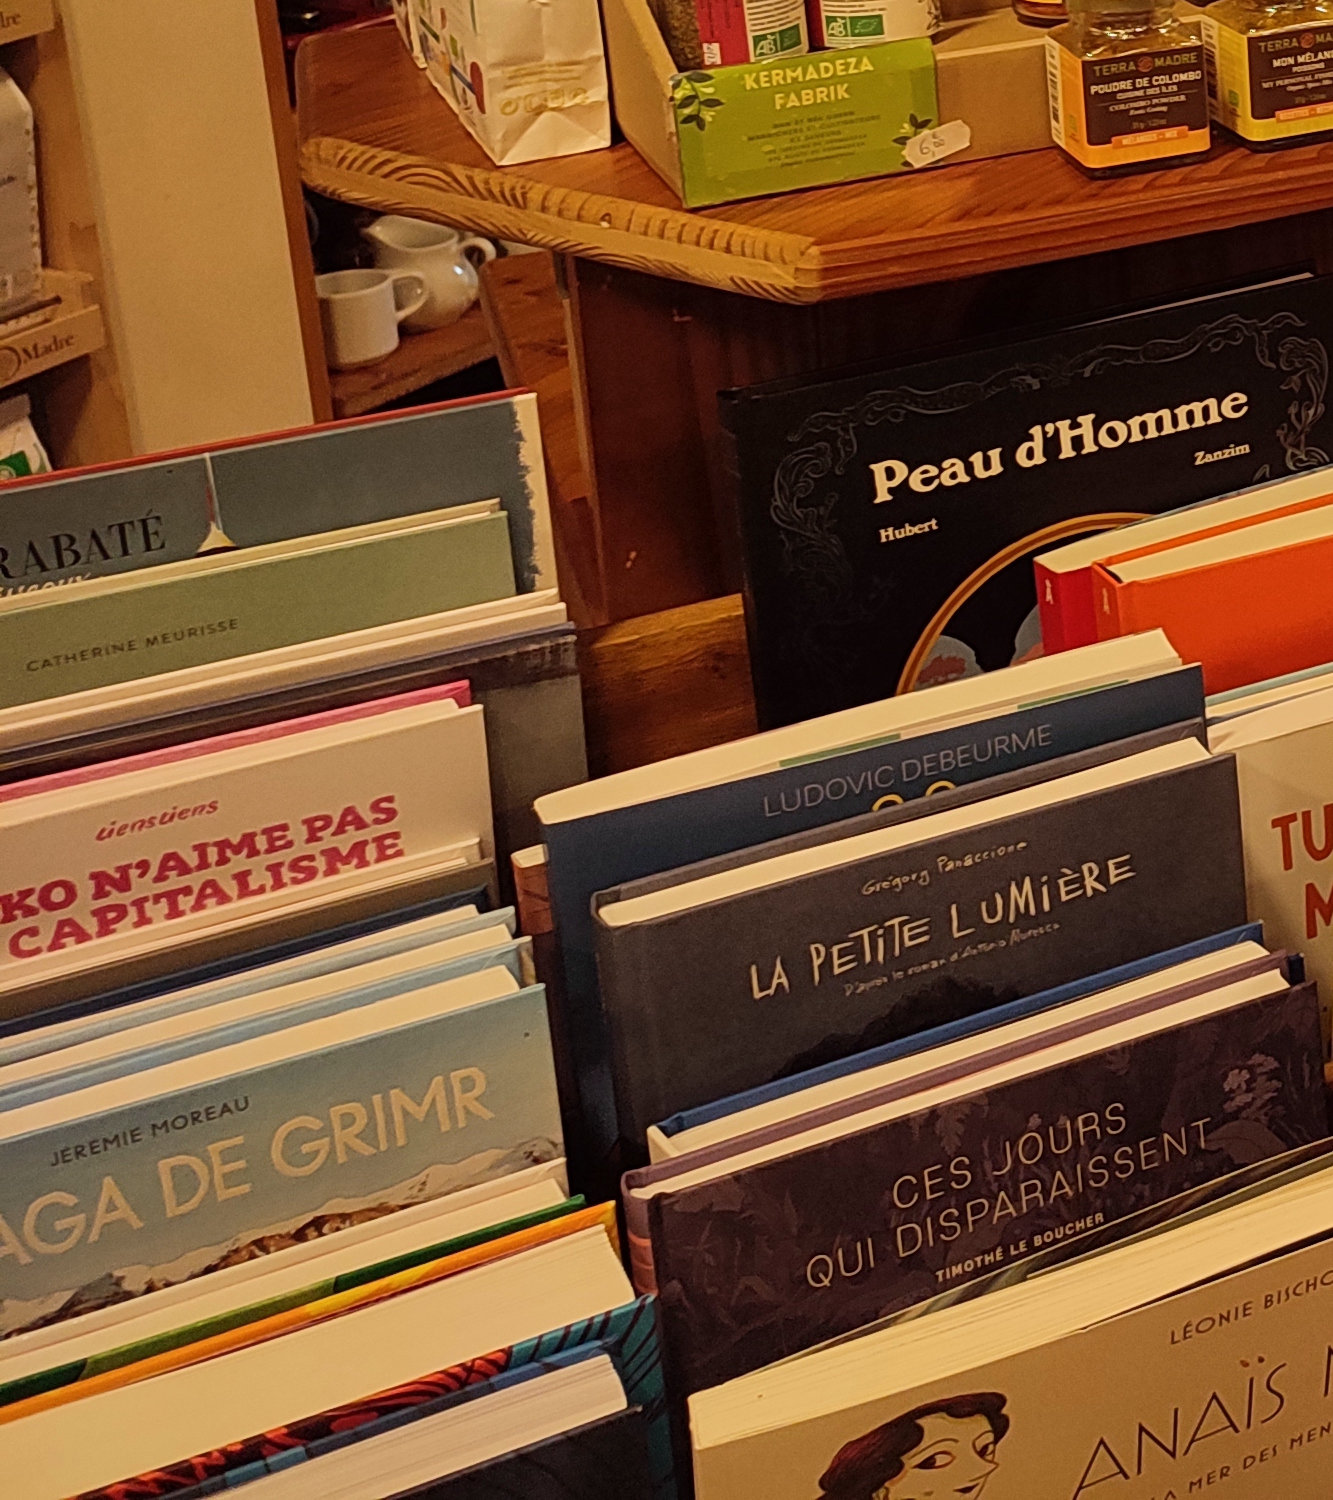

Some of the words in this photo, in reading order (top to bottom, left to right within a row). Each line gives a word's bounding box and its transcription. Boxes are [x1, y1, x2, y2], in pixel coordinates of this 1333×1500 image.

[1093, 64, 1136, 78] TERRA
[1154, 52, 1198, 67] MADRE
[1258, 40, 1299, 54] TERRA
[1272, 56, 1295, 69] MON
[744, 55, 874, 90] KERMADEZA
[775, 82, 850, 110] FABRIK
[1090, 81, 1133, 95] POUDRE
[1135, 77, 1150, 89] DE
[1152, 70, 1201, 85] COLOMBO
[869, 448, 1005, 505] Peau
[1014, 391, 1250, 468] d'Homme
[1193, 443, 1251, 467] Zanzim
[880, 517, 939, 543] Hubert
[26, 638, 139, 674] CATHERINE
[145, 617, 240, 649] MEURISSE
[763, 764, 897, 819] LUDOVIC
[902, 723, 1053, 782] DEBEURME
[91, 823, 295, 903] N'AIME
[301, 793, 400, 846] PAS
[937, 842, 1028, 874] Panaccione
[8, 830, 404, 961] CAPITALISME
[749, 953, 792, 1001] LA
[149, 1095, 252, 1138] MOREAU
[157, 1135, 253, 1219] DE
[270, 1065, 496, 1180] GRIMR
[892, 1154, 972, 1211] CES
[994, 1102, 1128, 1178] JOURS
[804, 1232, 876, 1291] QUI
[895, 1116, 1215, 1257] DISPARAISSENT
[935, 1245, 1006, 1285] TIMOTHÉ
[1009, 1236, 1030, 1260] LE
[1032, 1210, 1106, 1255] BOUCHER
[1169, 1299, 1256, 1347] LÉONIE
[1071, 1353, 1290, 1500] ANAÏS
[1189, 1463, 1233, 1495] MER
[1242, 1443, 1280, 1475] DES
